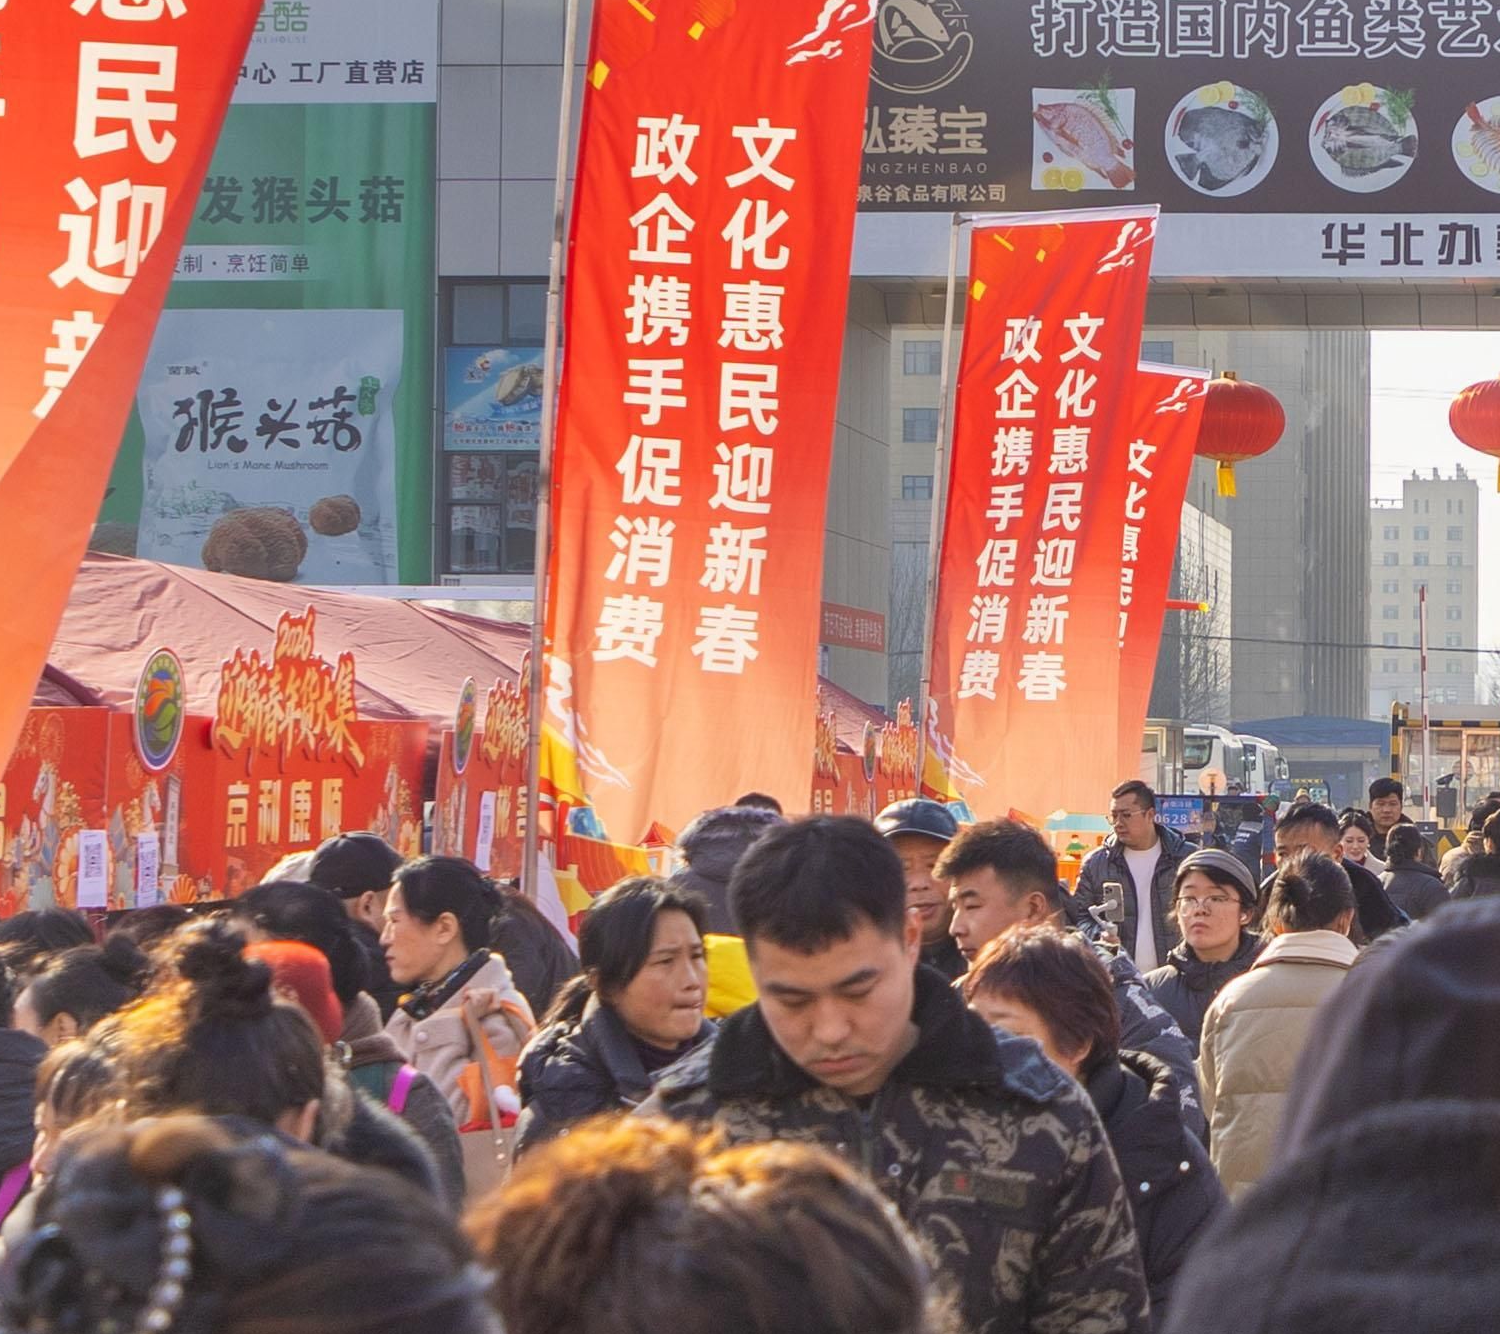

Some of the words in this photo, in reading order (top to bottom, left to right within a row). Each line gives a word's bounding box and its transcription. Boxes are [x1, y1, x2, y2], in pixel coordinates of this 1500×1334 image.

[289, 60, 425, 85] 工厂直营店
[200, 175, 404, 224] 发猴头菇
[172, 385, 362, 453] 猴头菇
[593, 113, 700, 669] 政企携手促消费
[691, 117, 797, 674] 文化惠民迎新春
[957, 315, 1042, 701] 政企携手促消费
[1017, 312, 1104, 702] 文化惠民迎新春
[216, 663, 365, 768] 迎新春年货大集
[226, 778, 343, 847] 京利康顺
